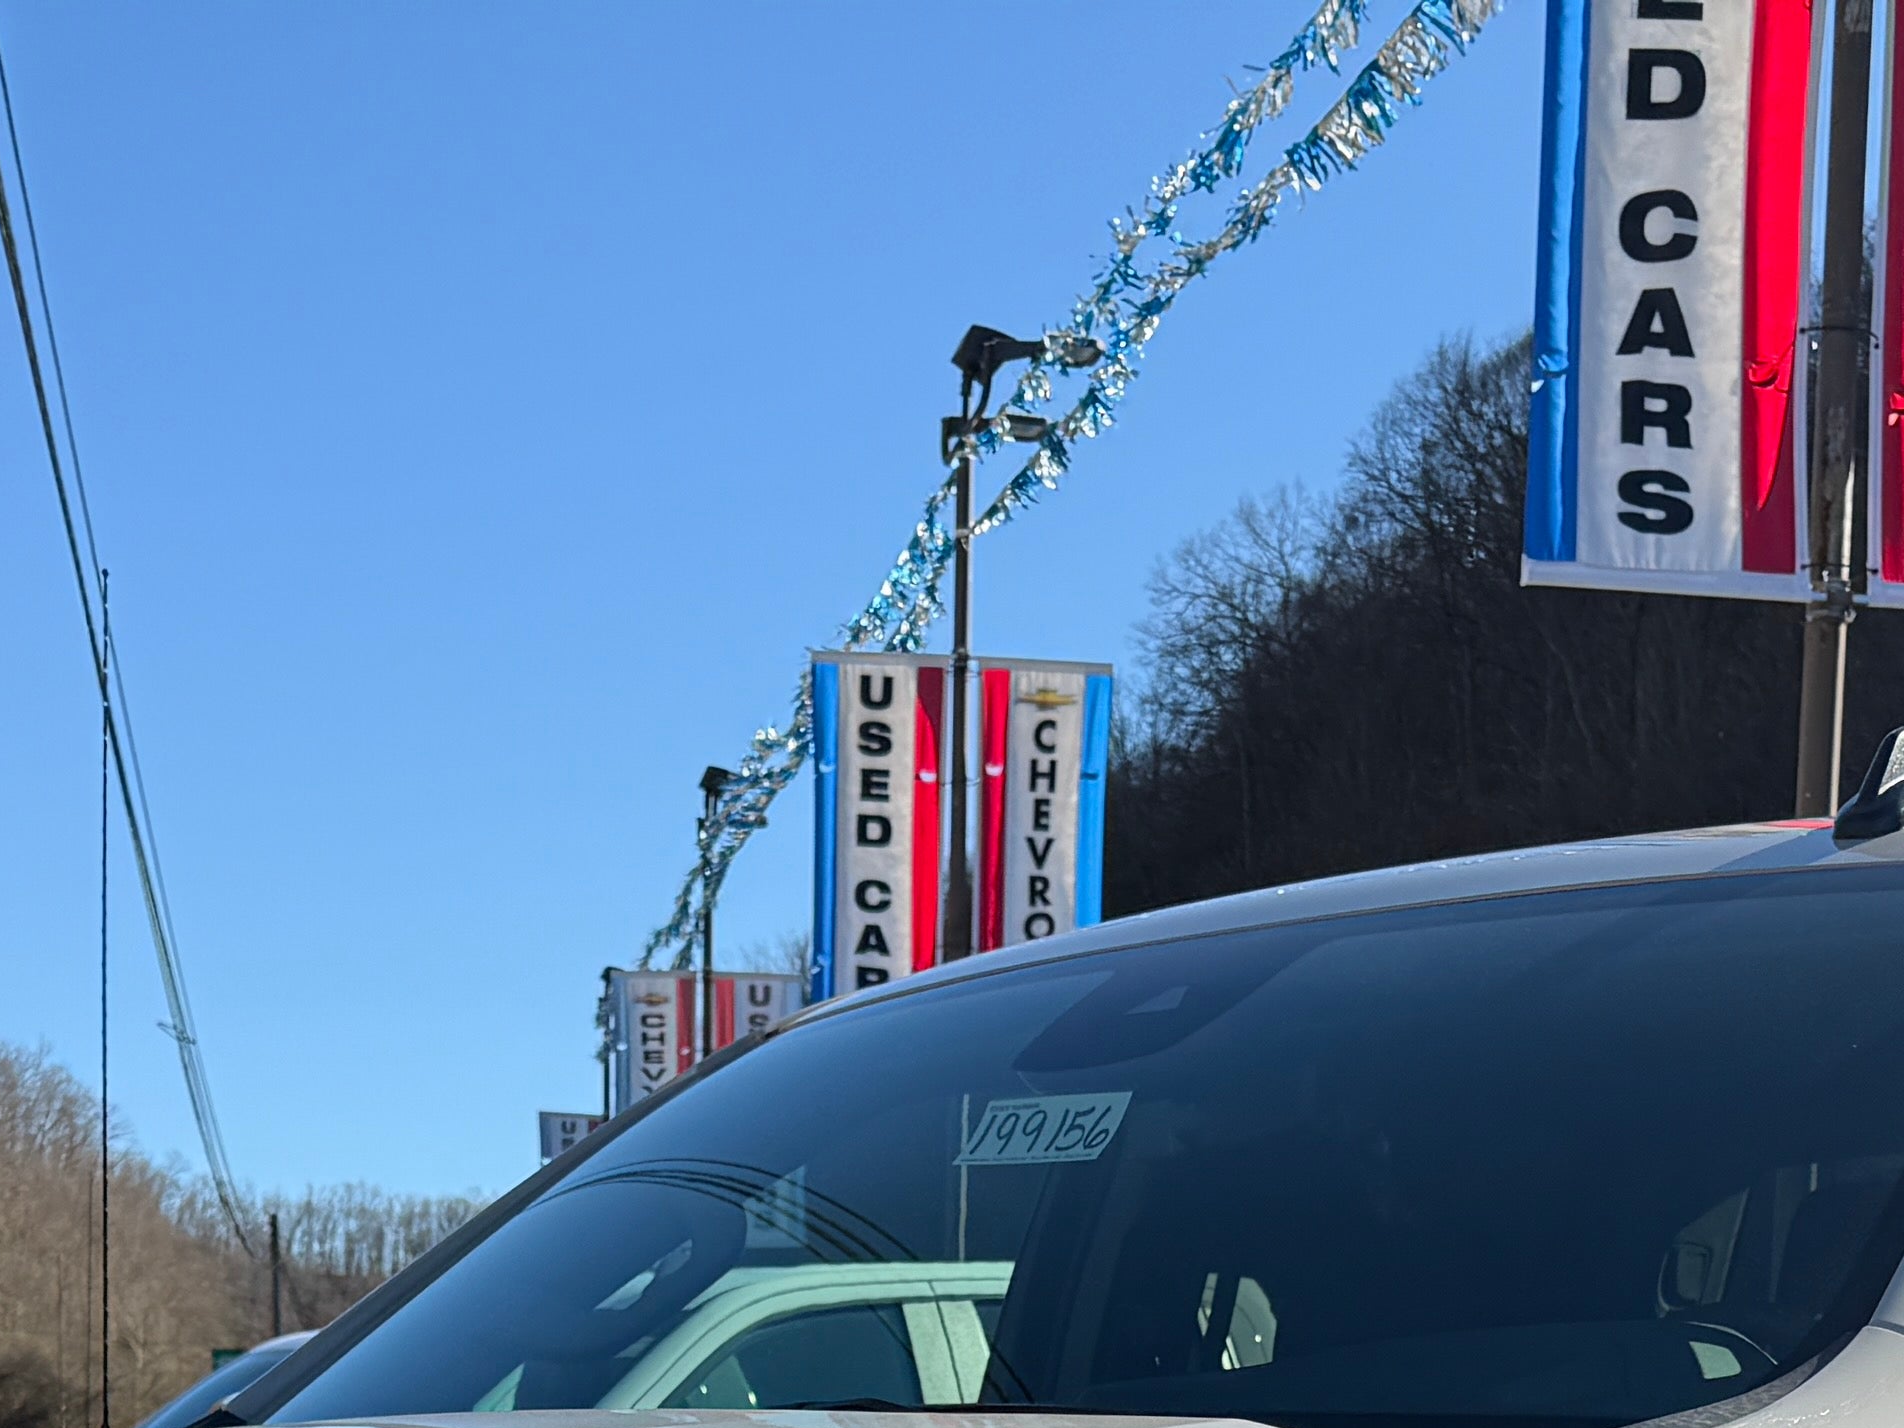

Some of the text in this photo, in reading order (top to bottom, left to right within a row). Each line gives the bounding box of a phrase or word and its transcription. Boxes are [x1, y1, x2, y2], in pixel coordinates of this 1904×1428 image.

[1616, 189, 1699, 536] CARS
[855, 675, 893, 848] USED
[969, 1105, 1112, 1155] 199156
